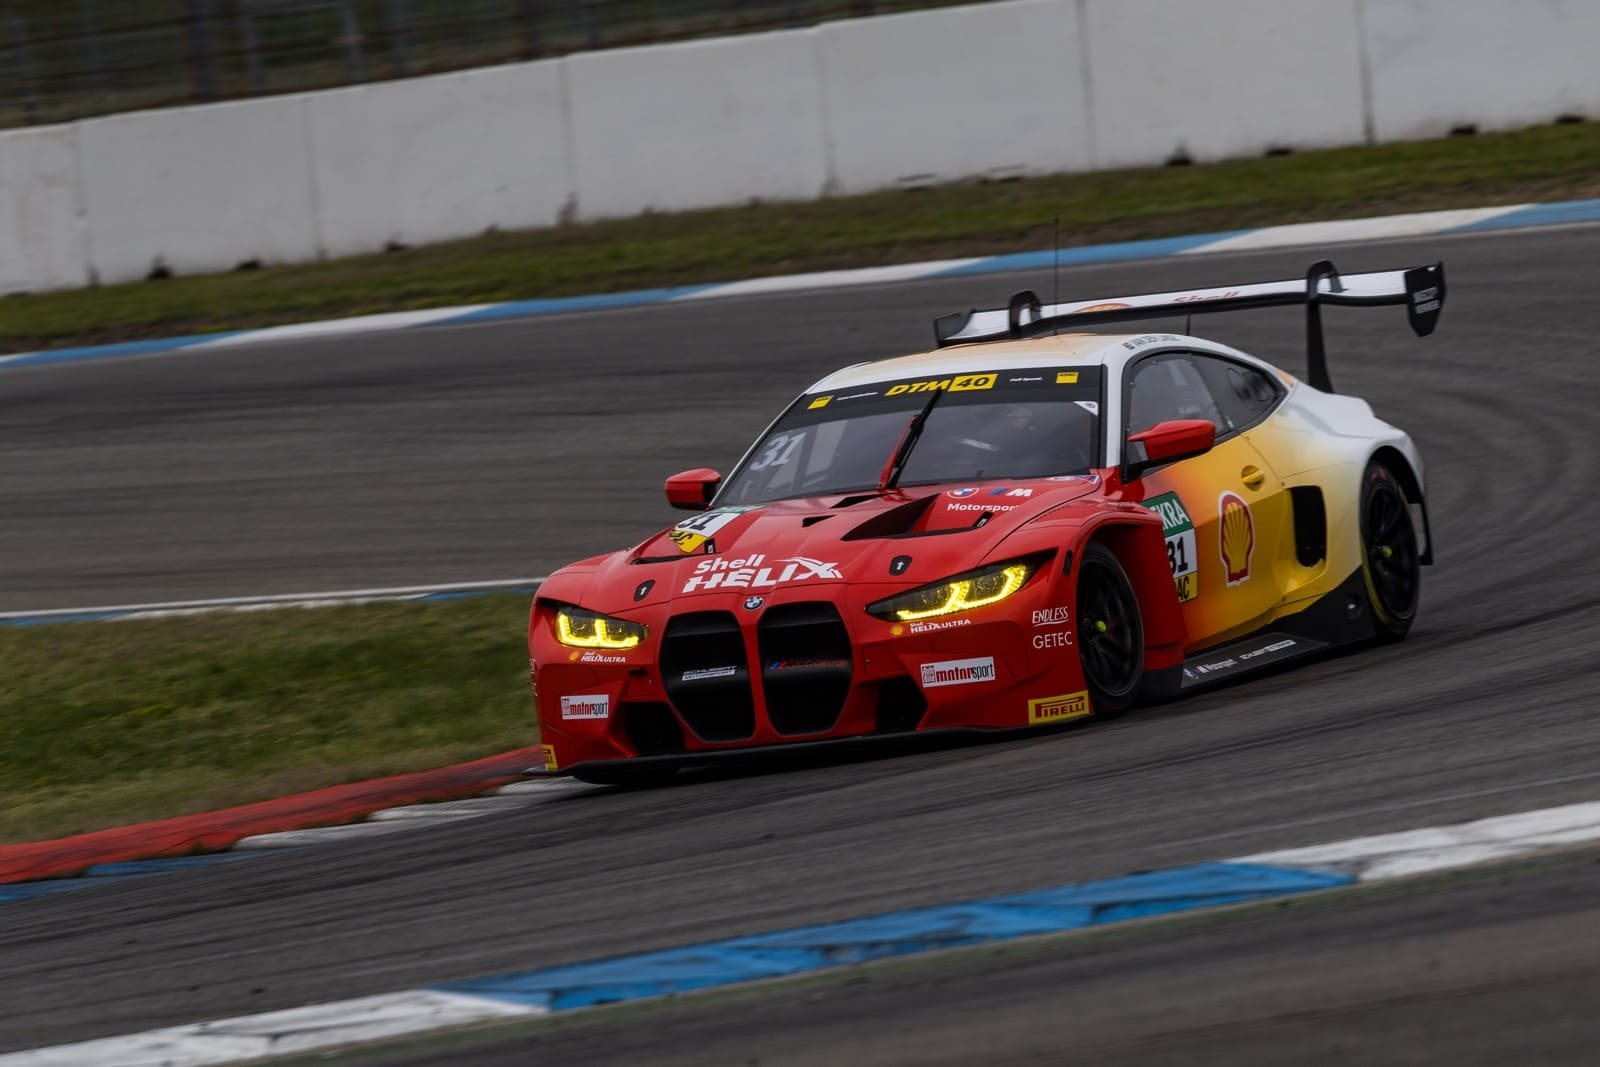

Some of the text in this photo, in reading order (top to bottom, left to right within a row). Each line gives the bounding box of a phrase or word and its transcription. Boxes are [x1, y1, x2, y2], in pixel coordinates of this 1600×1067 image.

[885, 380, 951, 397] DTM
[956, 376, 990, 389] 40
[750, 432, 807, 471] 31
[1149, 499, 1190, 531] KRA
[681, 556, 843, 594] HELIX
[694, 554, 766, 575] Shell
[1032, 606, 1069, 624] ENDLESS
[910, 619, 972, 634] HELIX ULTRA
[1033, 631, 1073, 649] GETEC
[936, 663, 994, 683] motorsport
[569, 701, 608, 717] motorsport
[1035, 696, 1085, 718] PIRELLI
